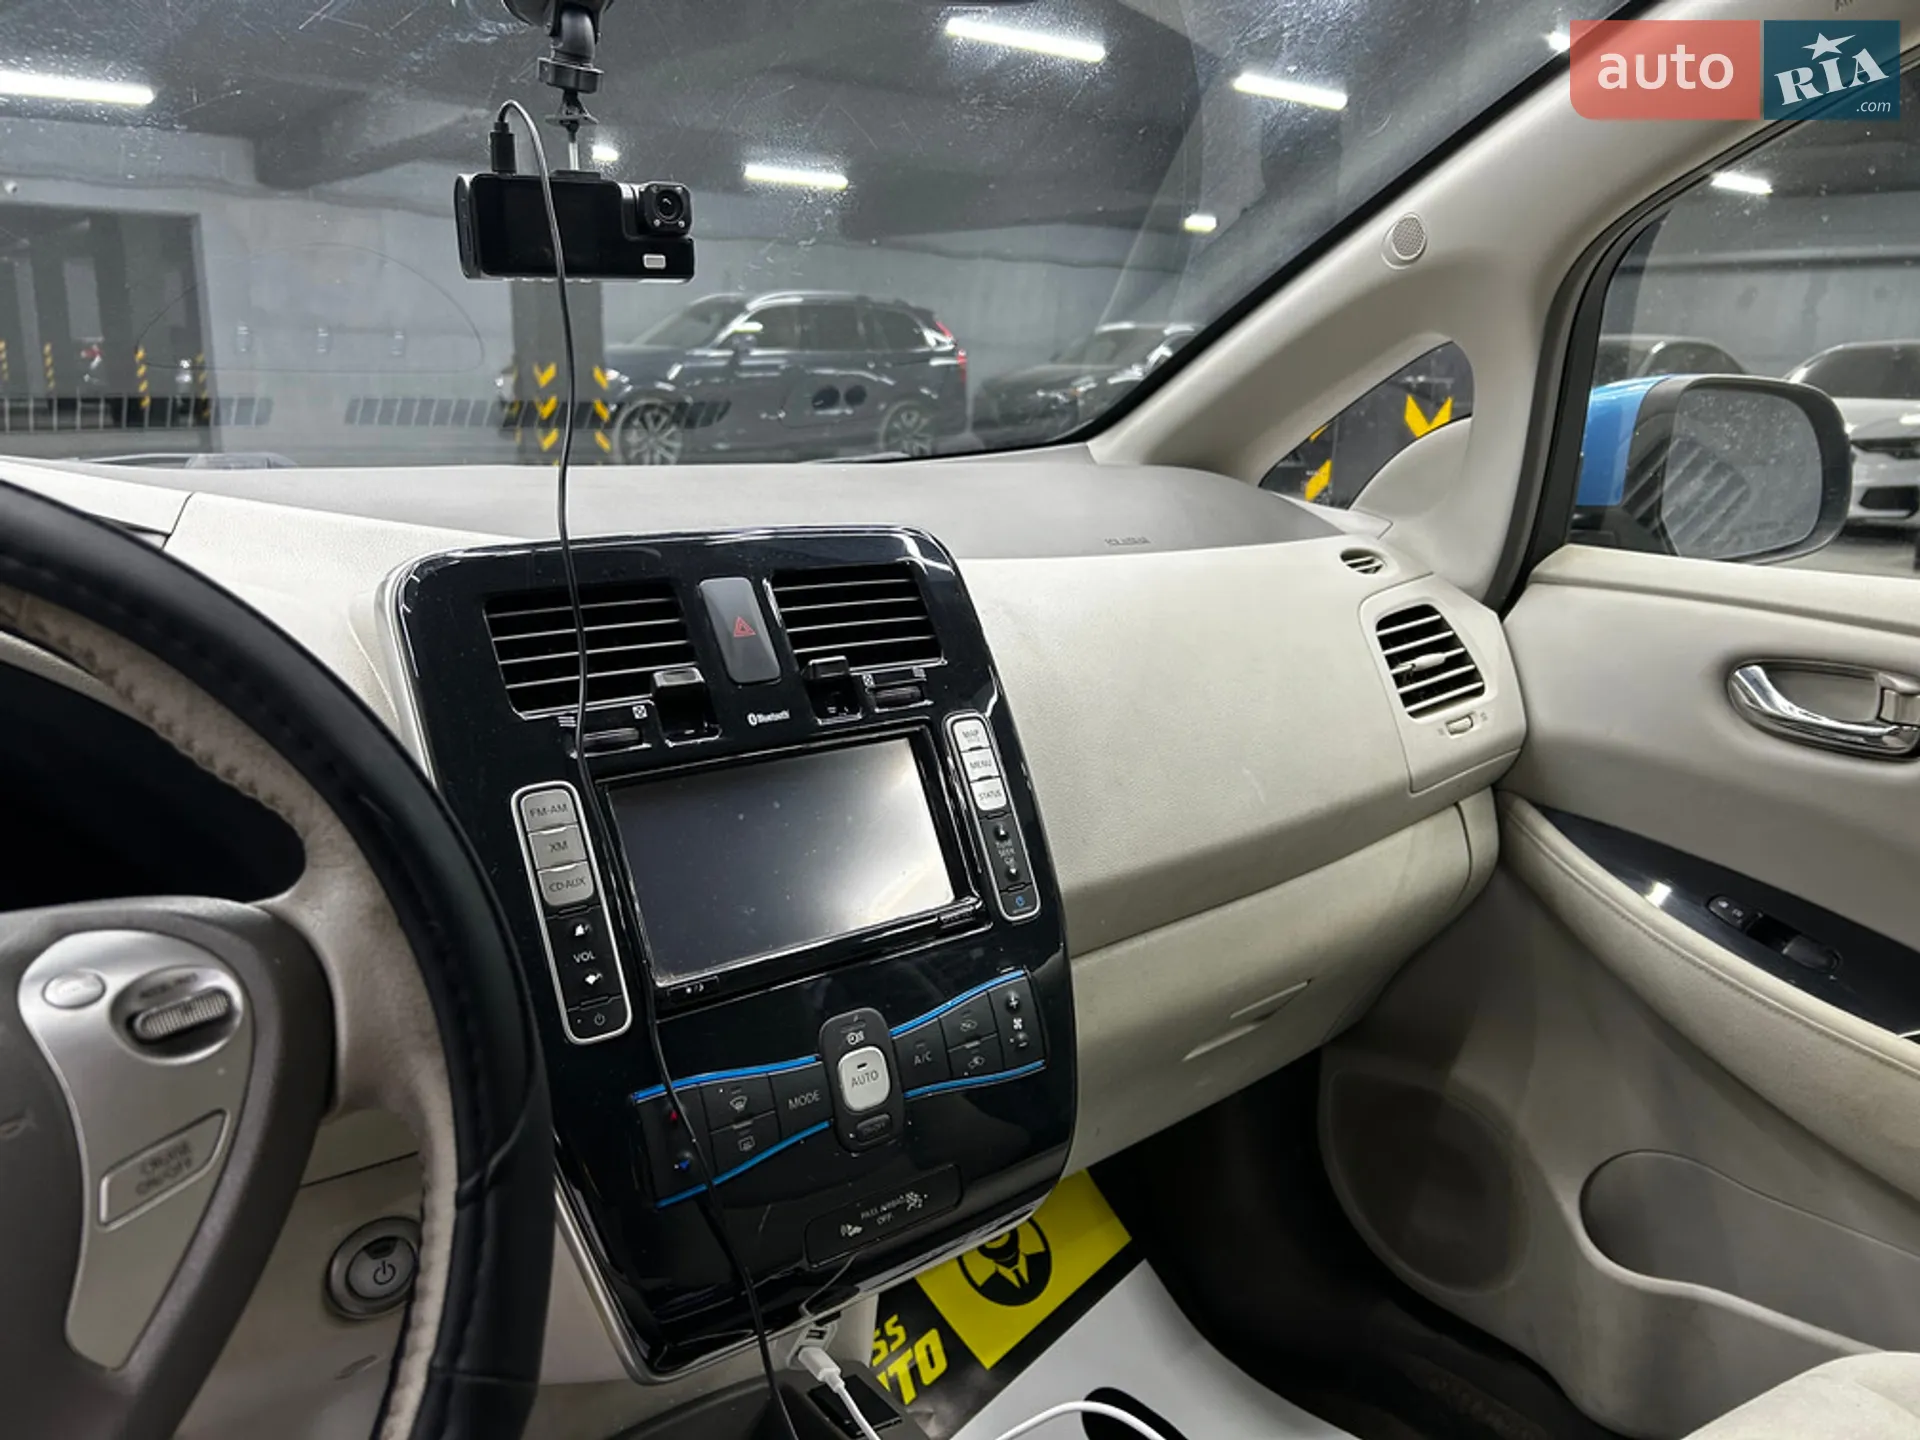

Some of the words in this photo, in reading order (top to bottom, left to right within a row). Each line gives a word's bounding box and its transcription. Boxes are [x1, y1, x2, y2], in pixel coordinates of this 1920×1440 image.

[969, 759, 992, 769] MENU
[978, 789, 1003, 800] STATUS
[549, 840, 568, 852] XM
[573, 951, 596, 964] VOL
[914, 1051, 932, 1065] A/C
[851, 1070, 880, 1088] AUTO
[788, 1090, 821, 1110] MODE
